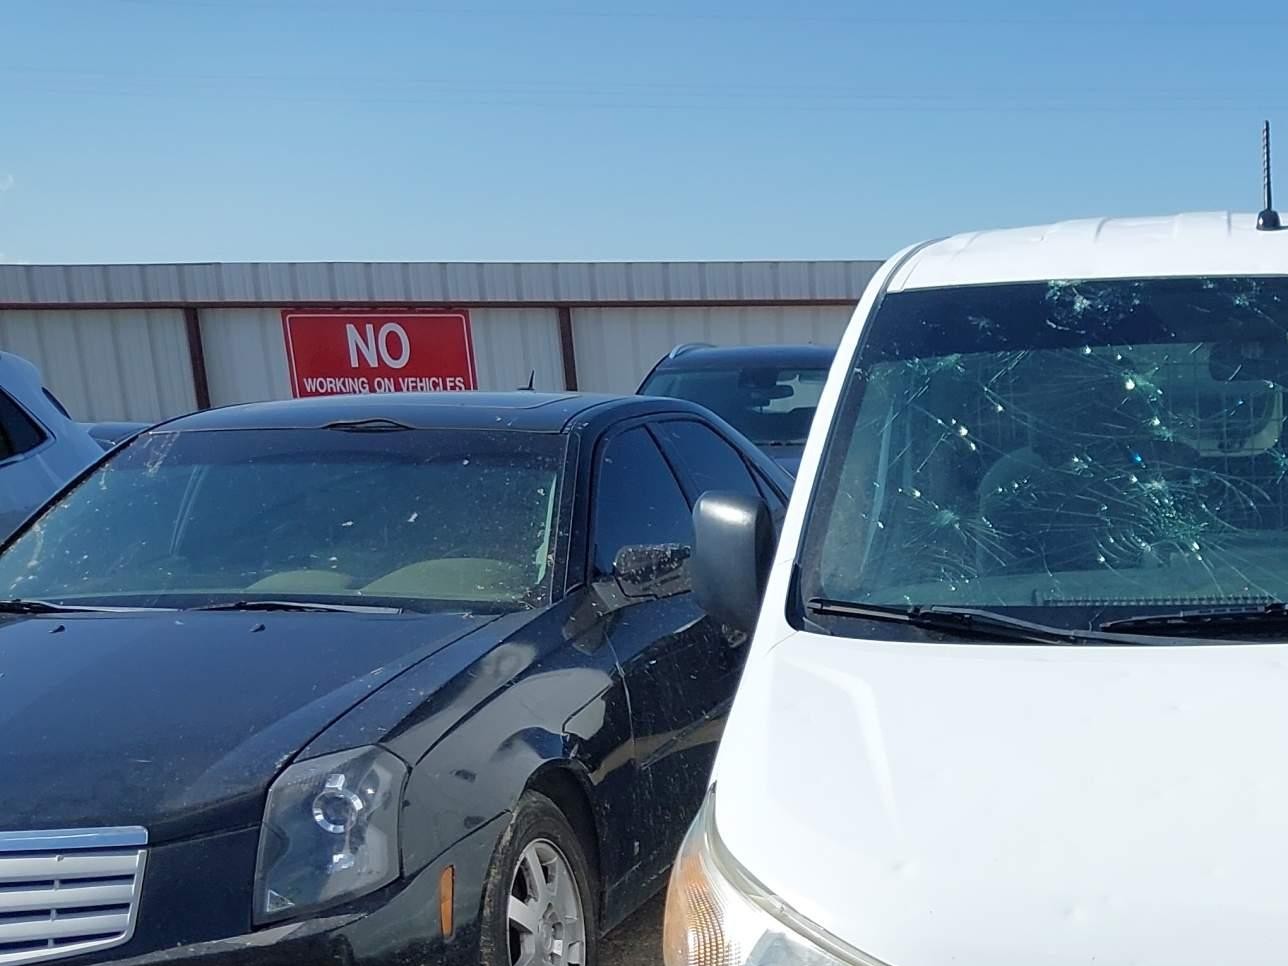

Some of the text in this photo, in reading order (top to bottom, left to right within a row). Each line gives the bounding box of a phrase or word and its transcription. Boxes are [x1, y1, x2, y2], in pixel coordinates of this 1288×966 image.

[346, 322, 411, 369] NO
[303, 377, 466, 393] WORKING ON VEHICLES
